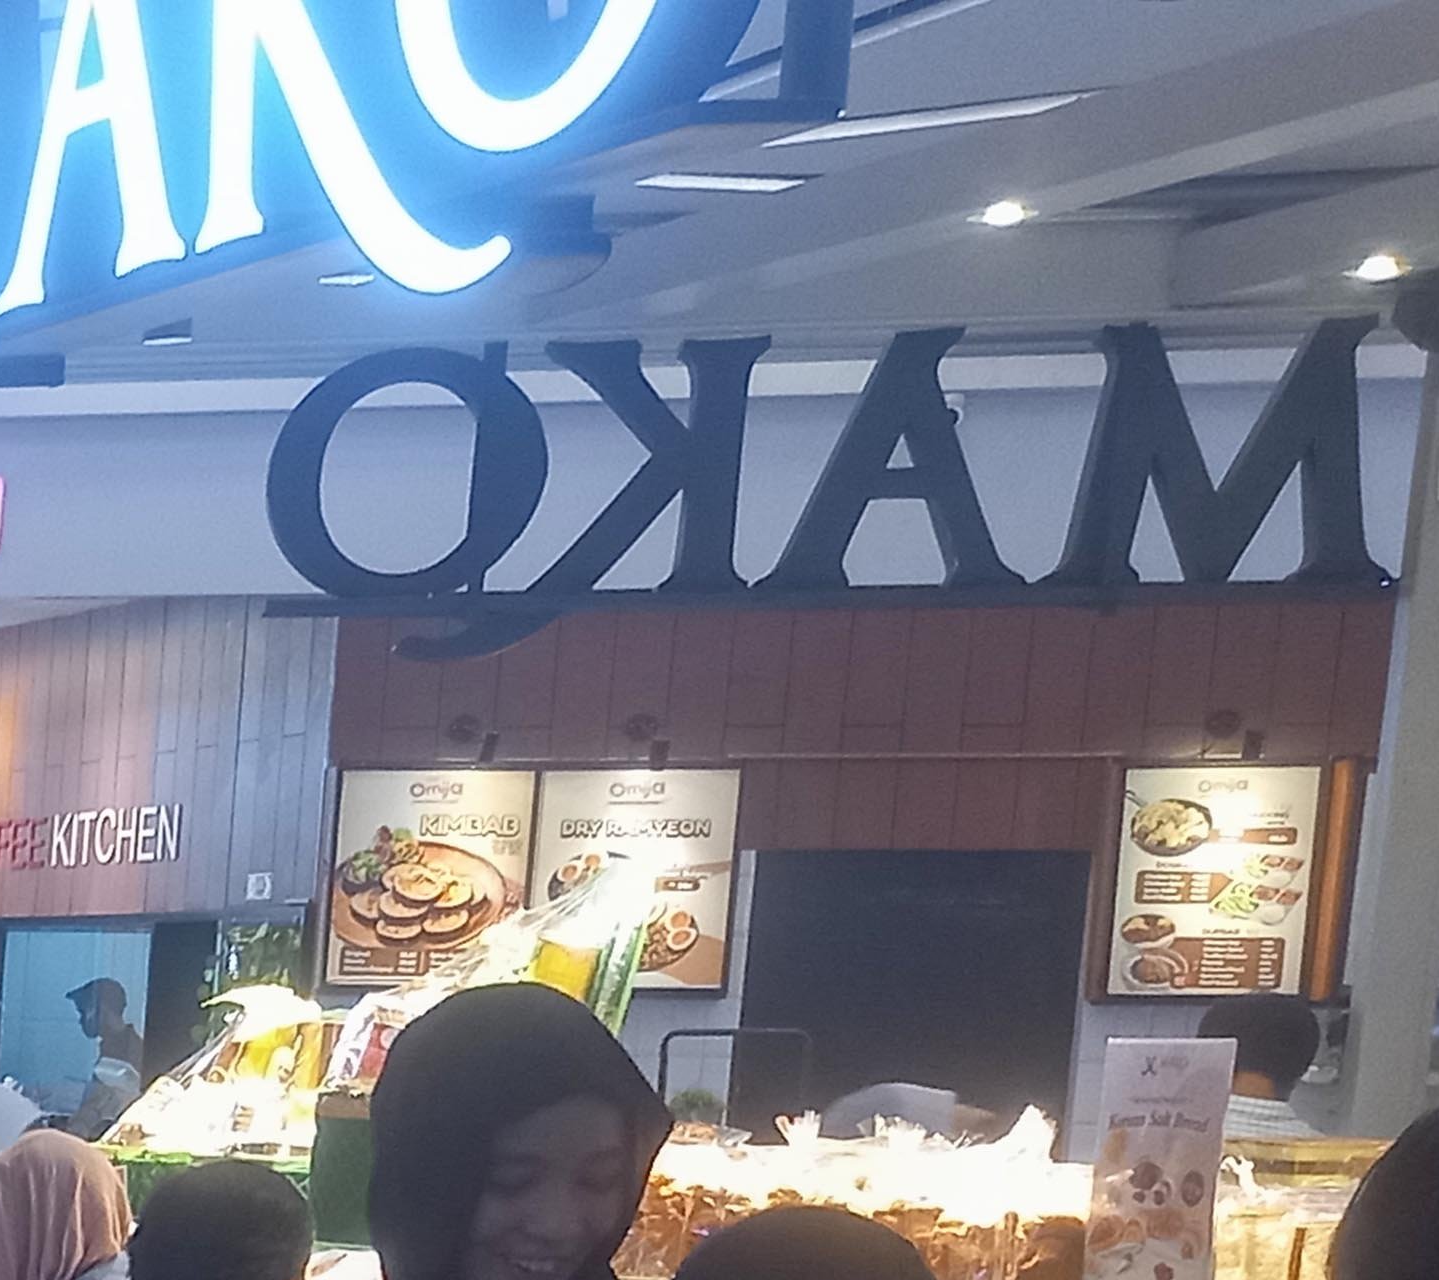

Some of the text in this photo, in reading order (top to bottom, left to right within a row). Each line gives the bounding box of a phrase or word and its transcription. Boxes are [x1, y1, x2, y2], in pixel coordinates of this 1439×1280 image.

[49, 803, 182, 867] KITCHEN
[420, 814, 521, 839] KIMBAB
[561, 818, 711, 839] DRY RAMYEON
